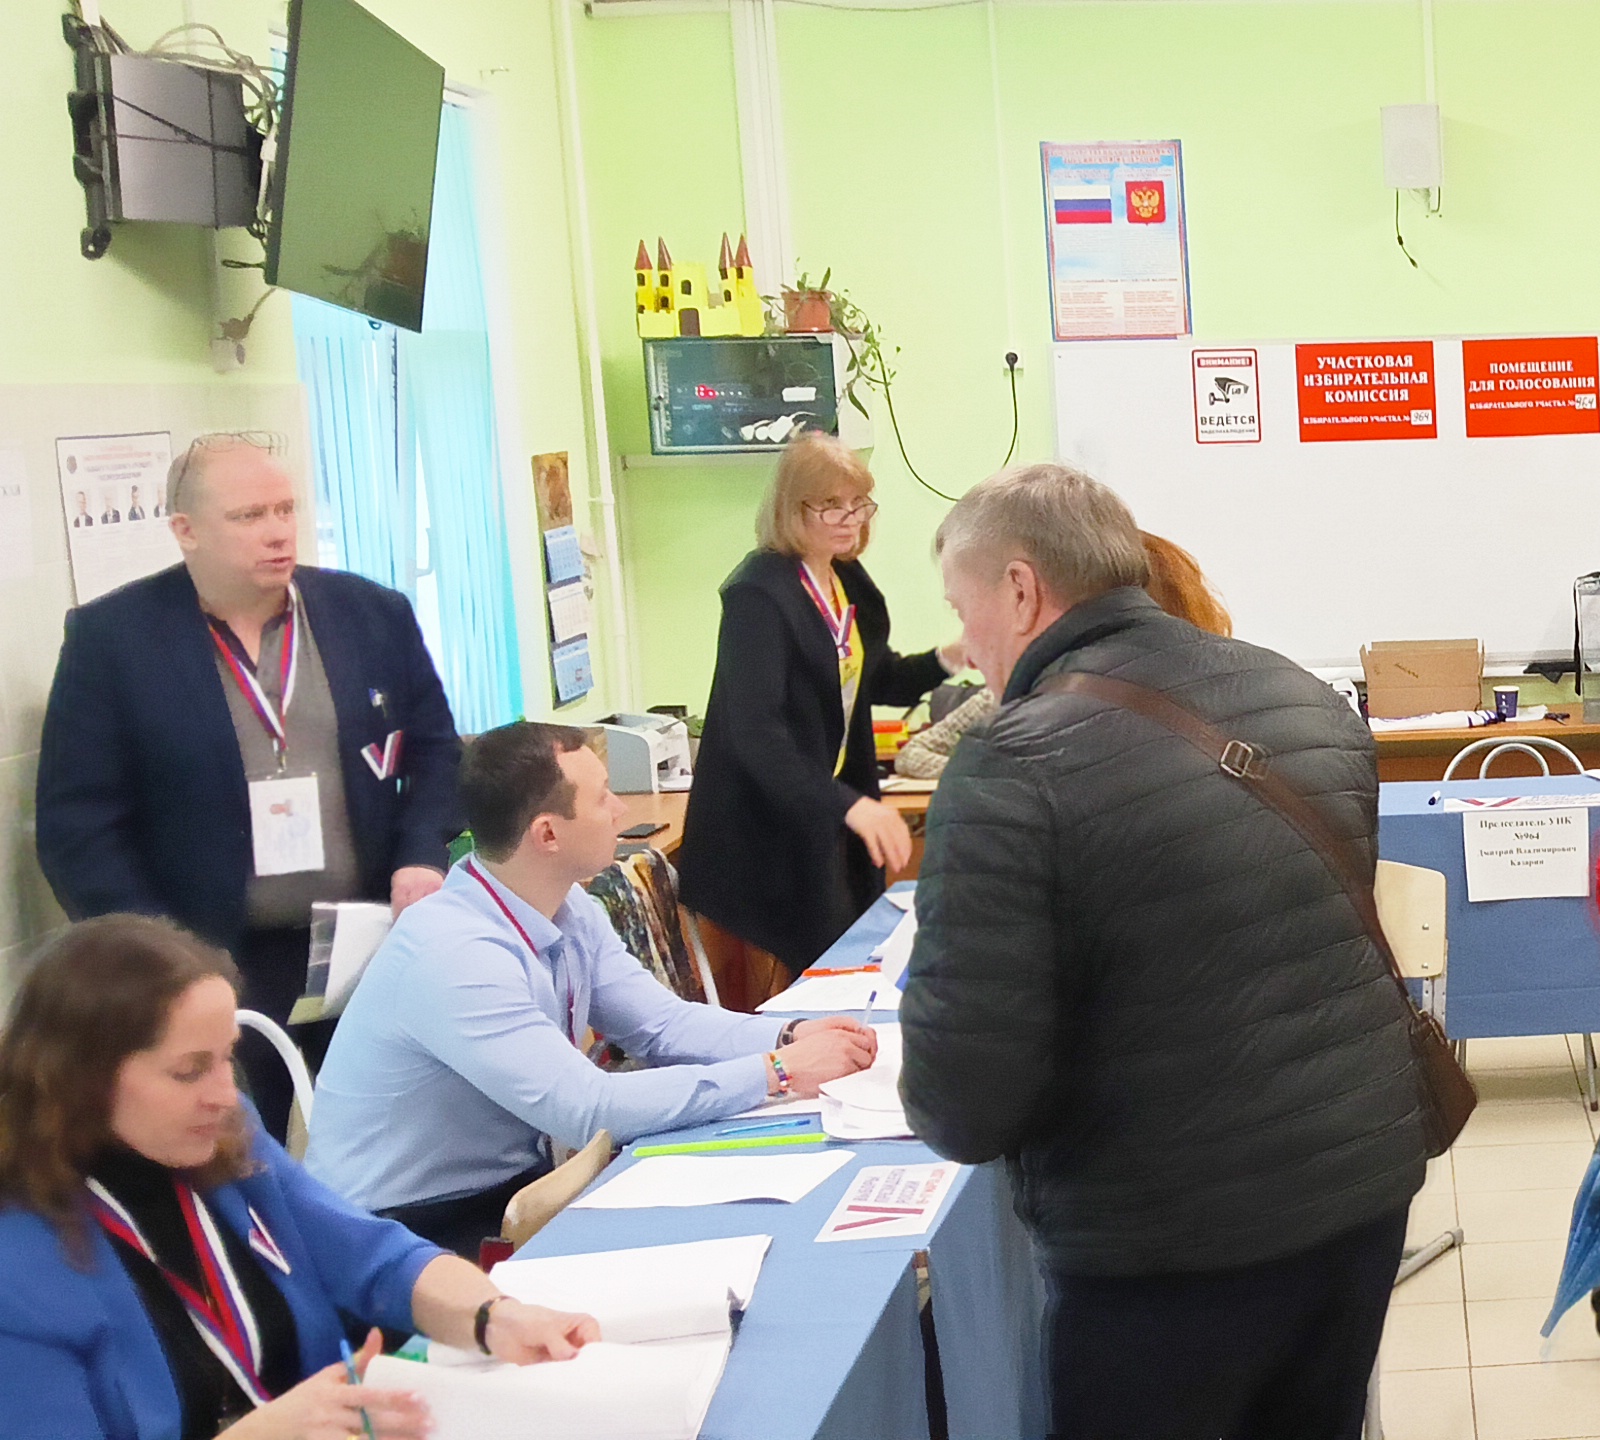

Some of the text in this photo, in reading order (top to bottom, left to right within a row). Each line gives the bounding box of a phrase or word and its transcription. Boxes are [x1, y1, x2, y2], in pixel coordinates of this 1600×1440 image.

[1200, 358, 1250, 366] ВНИМАНИЕ!
[1317, 355, 1413, 370] УЧАСТКОВАЯ
[1489, 360, 1574, 374] ПОМЕЩЕНИЕ
[1303, 371, 1428, 387] ИЗБИРАТЕЛЬНАЯ
[1468, 376, 1595, 393] ДЛЯ ГОЛОСОВАНИЯ
[1325, 389, 1409, 403] КОМИССИЯ
[1469, 401, 1534, 410] ИЗБИРАТЕЛЬНОГО
[1535, 399, 1566, 408] УЧАСТКА
[1200, 413, 1255, 426] ВЕДЁТСЯ
[1303, 415, 1368, 424] ИЗБИРАТЕЛЬНОГО
[1370, 415, 1400, 423] УЧАСТКА
[1480, 816, 1572, 830] Председатель УИК
[1513, 832, 1540, 840] №964
[1478, 846, 1577, 857] Дмитрий Владимирович
